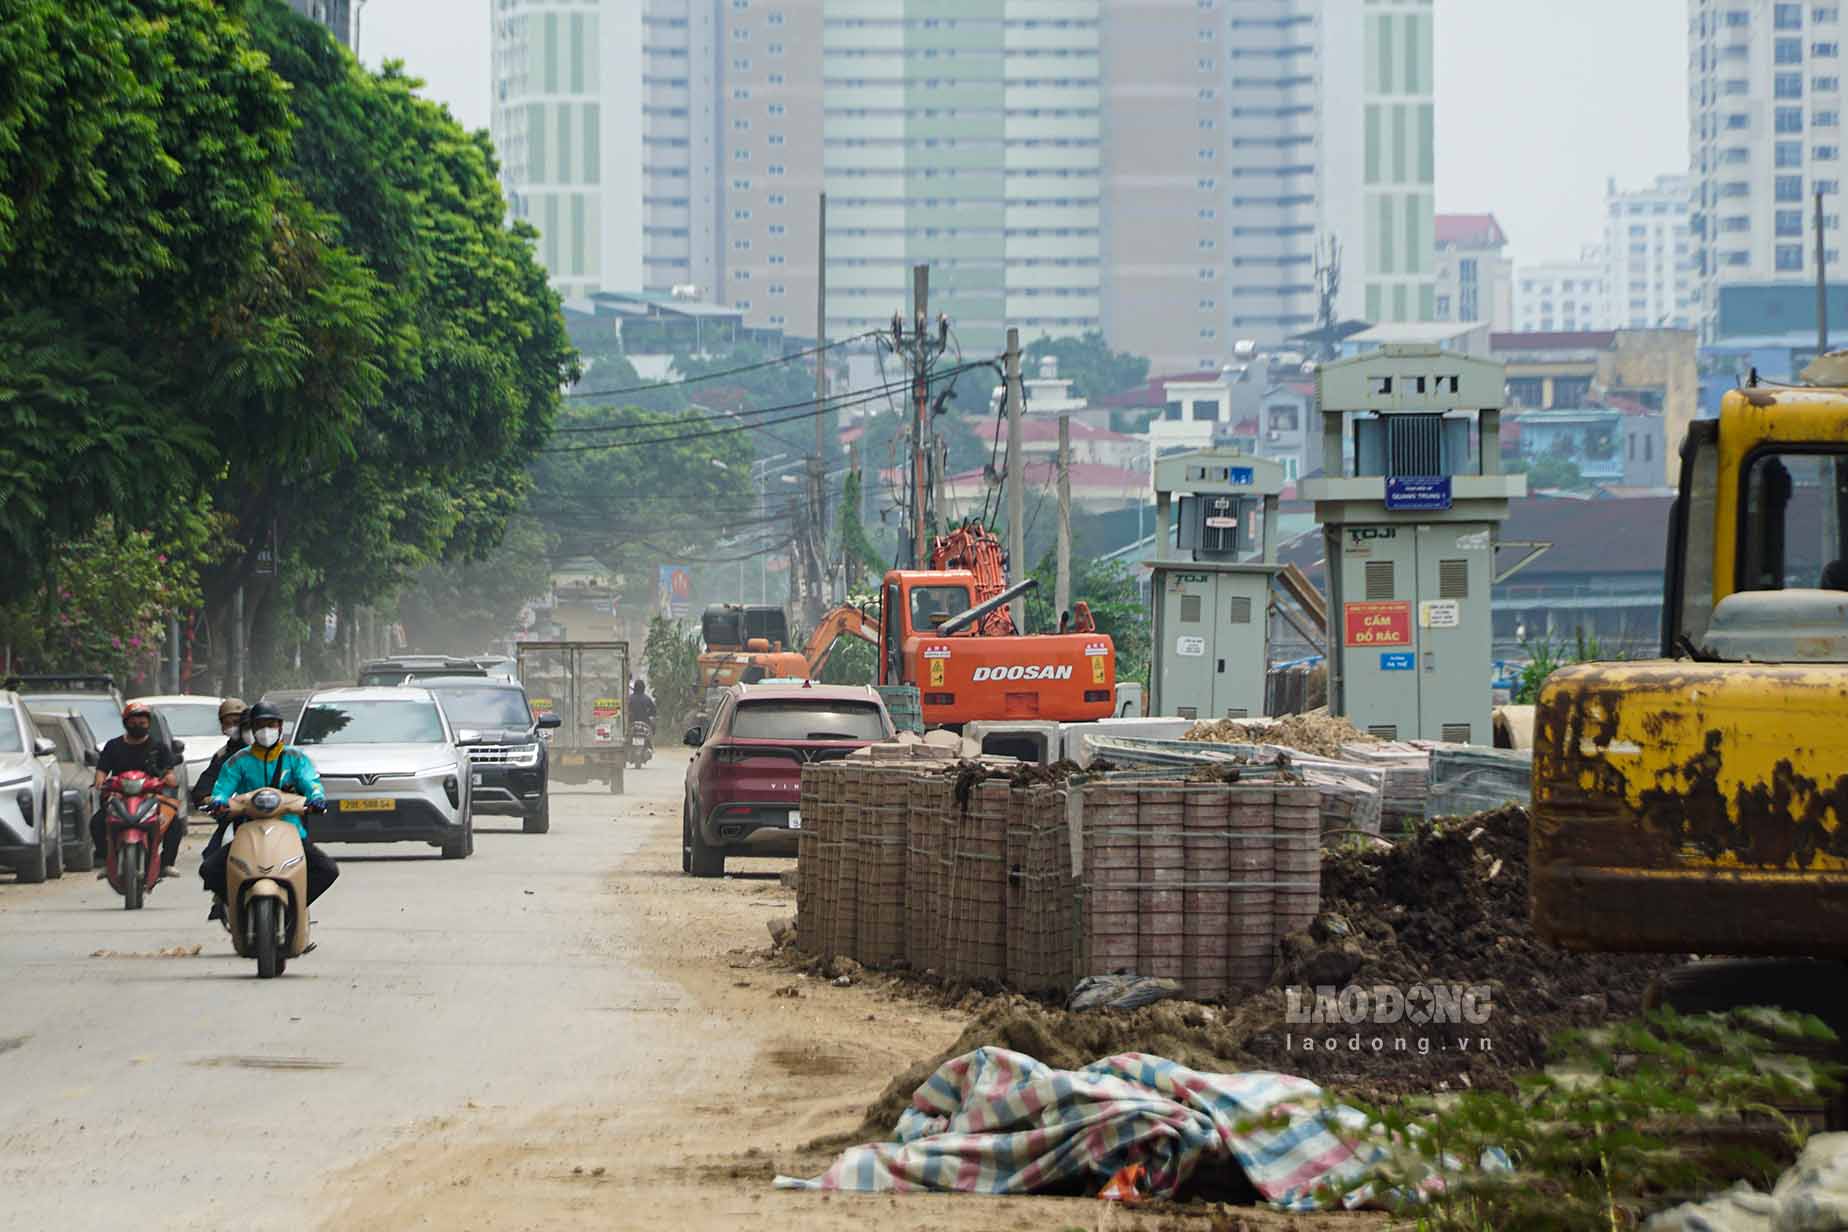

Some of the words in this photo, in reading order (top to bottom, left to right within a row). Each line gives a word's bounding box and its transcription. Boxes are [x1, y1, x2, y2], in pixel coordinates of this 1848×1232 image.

[1347, 527, 1396, 539] TOJI
[1176, 575, 1208, 583] TOJI
[972, 664, 1073, 681] DOOSAN
